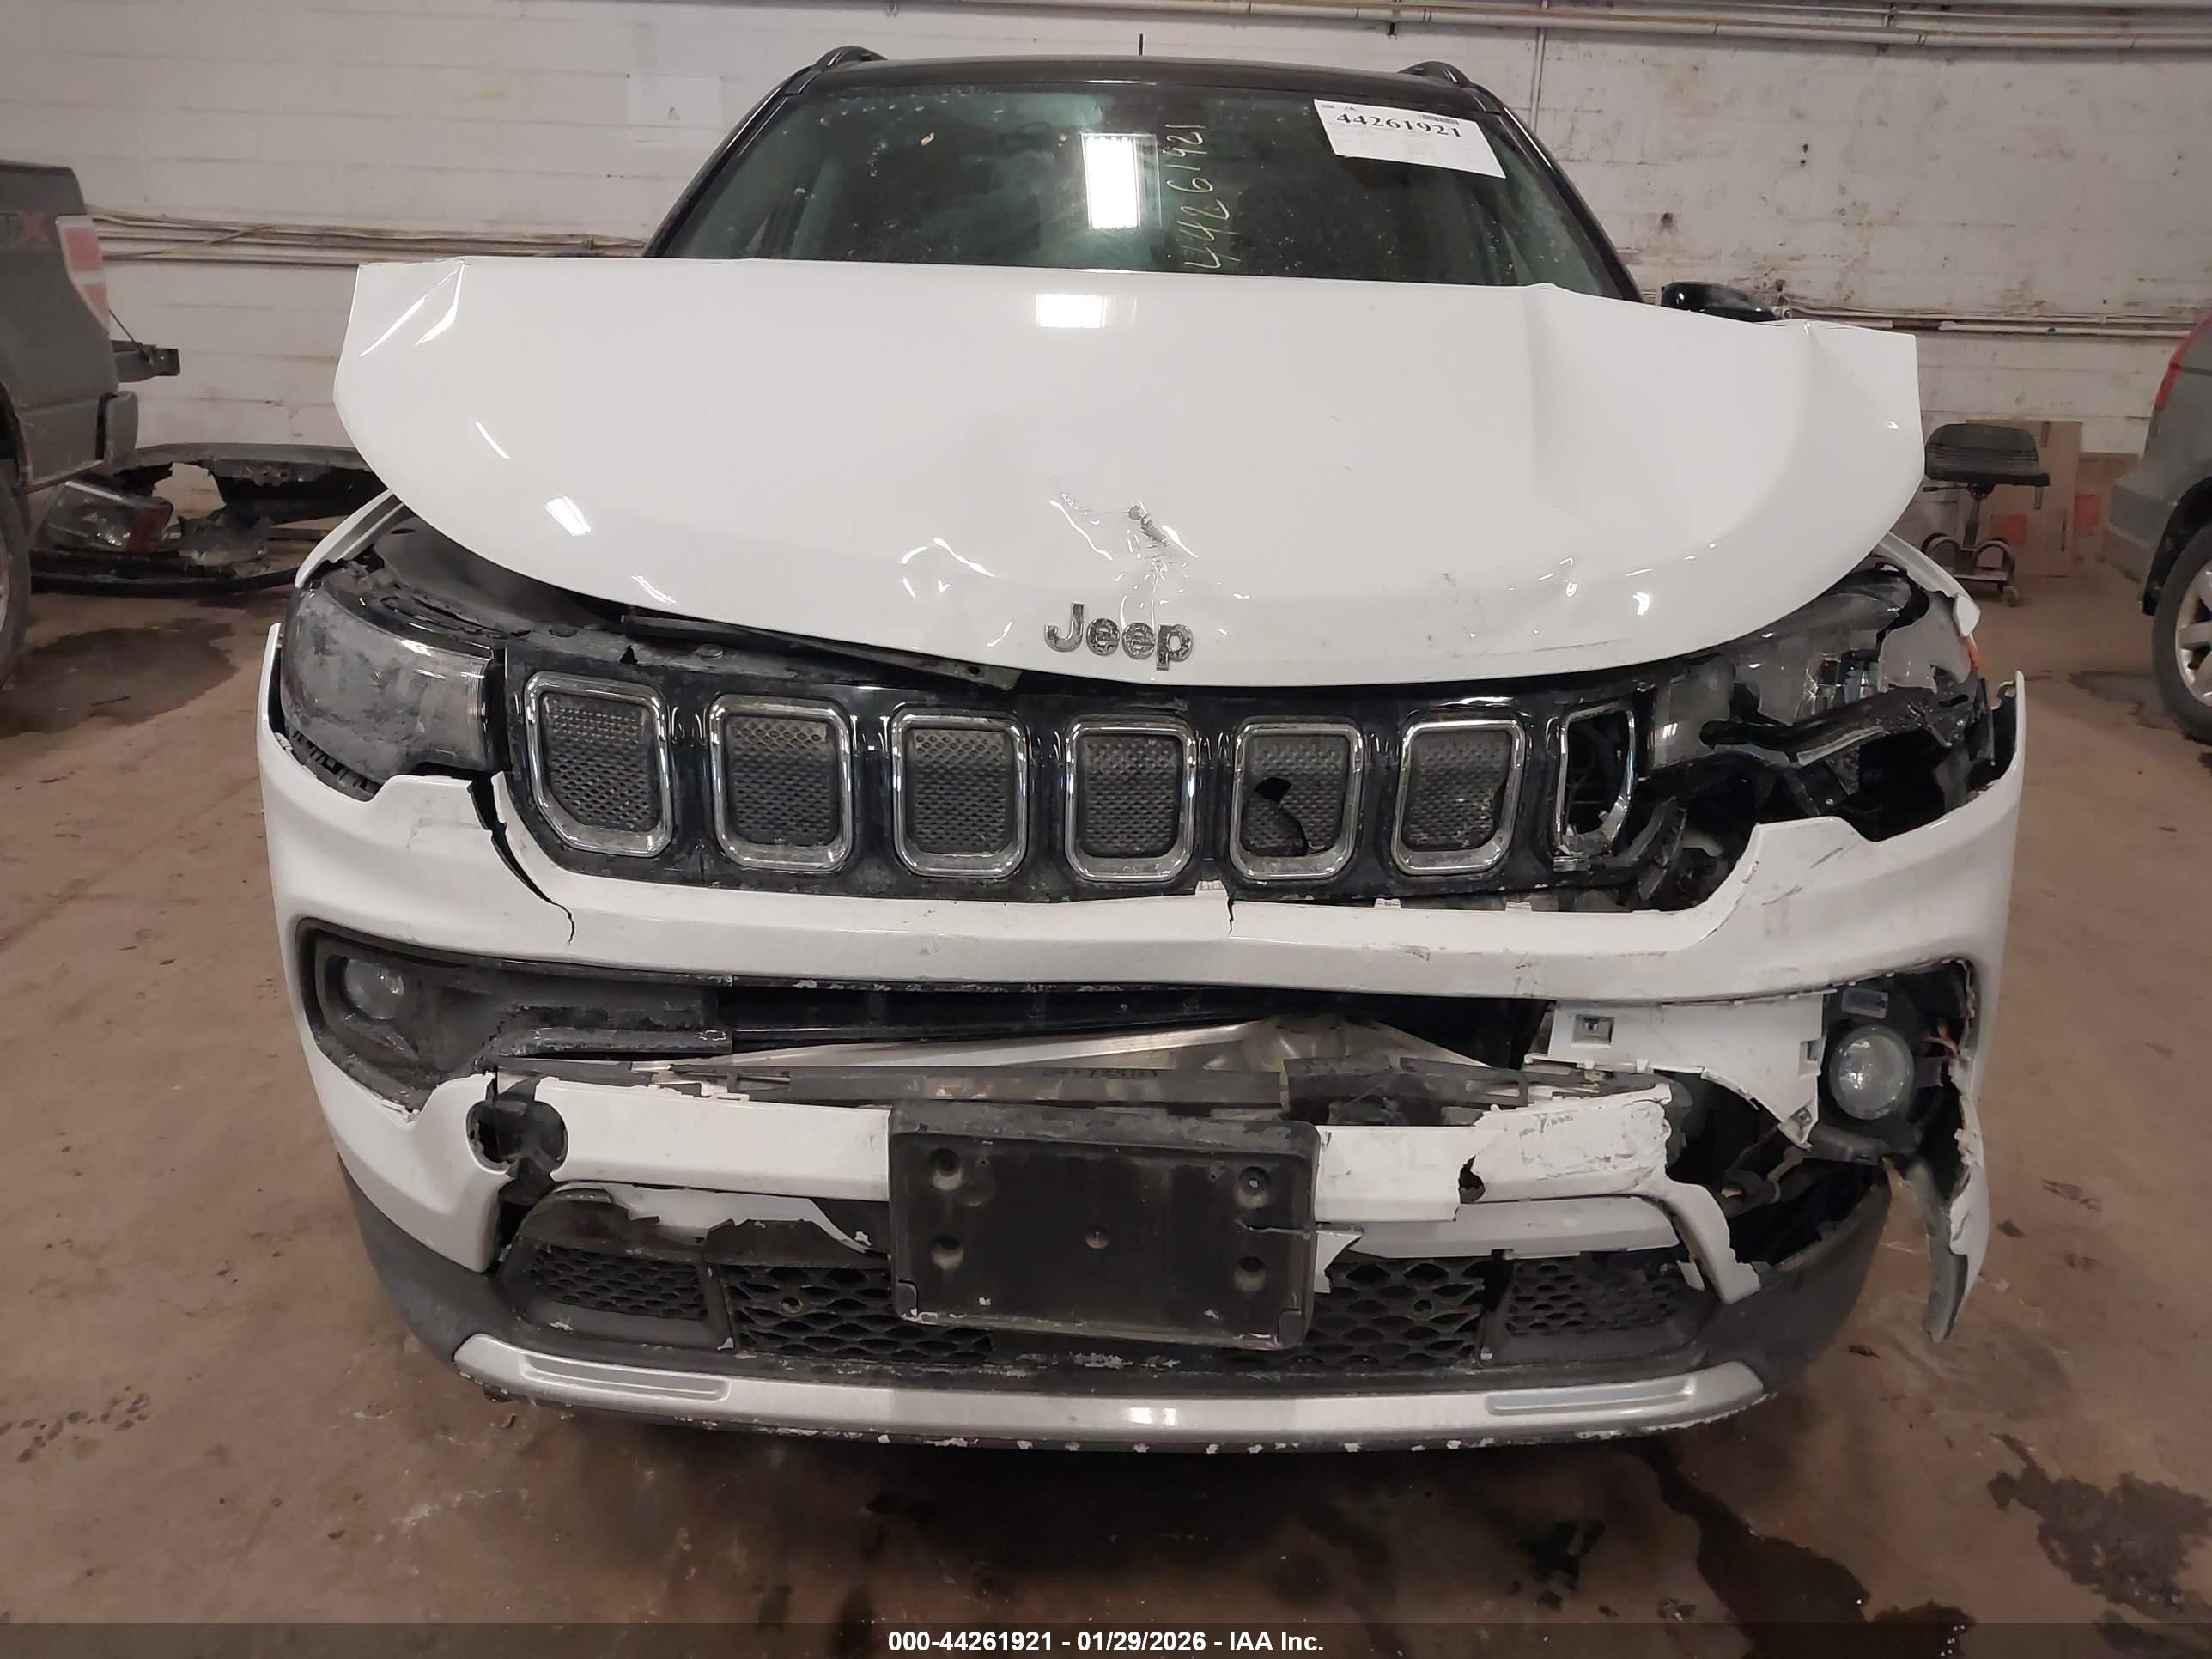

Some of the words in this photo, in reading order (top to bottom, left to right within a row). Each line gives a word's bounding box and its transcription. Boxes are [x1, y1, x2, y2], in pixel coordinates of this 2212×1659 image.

[1336, 113, 1462, 137] 44261921
[1162, 124, 1241, 268] 44261921
[1043, 602, 1194, 671] Jeep
